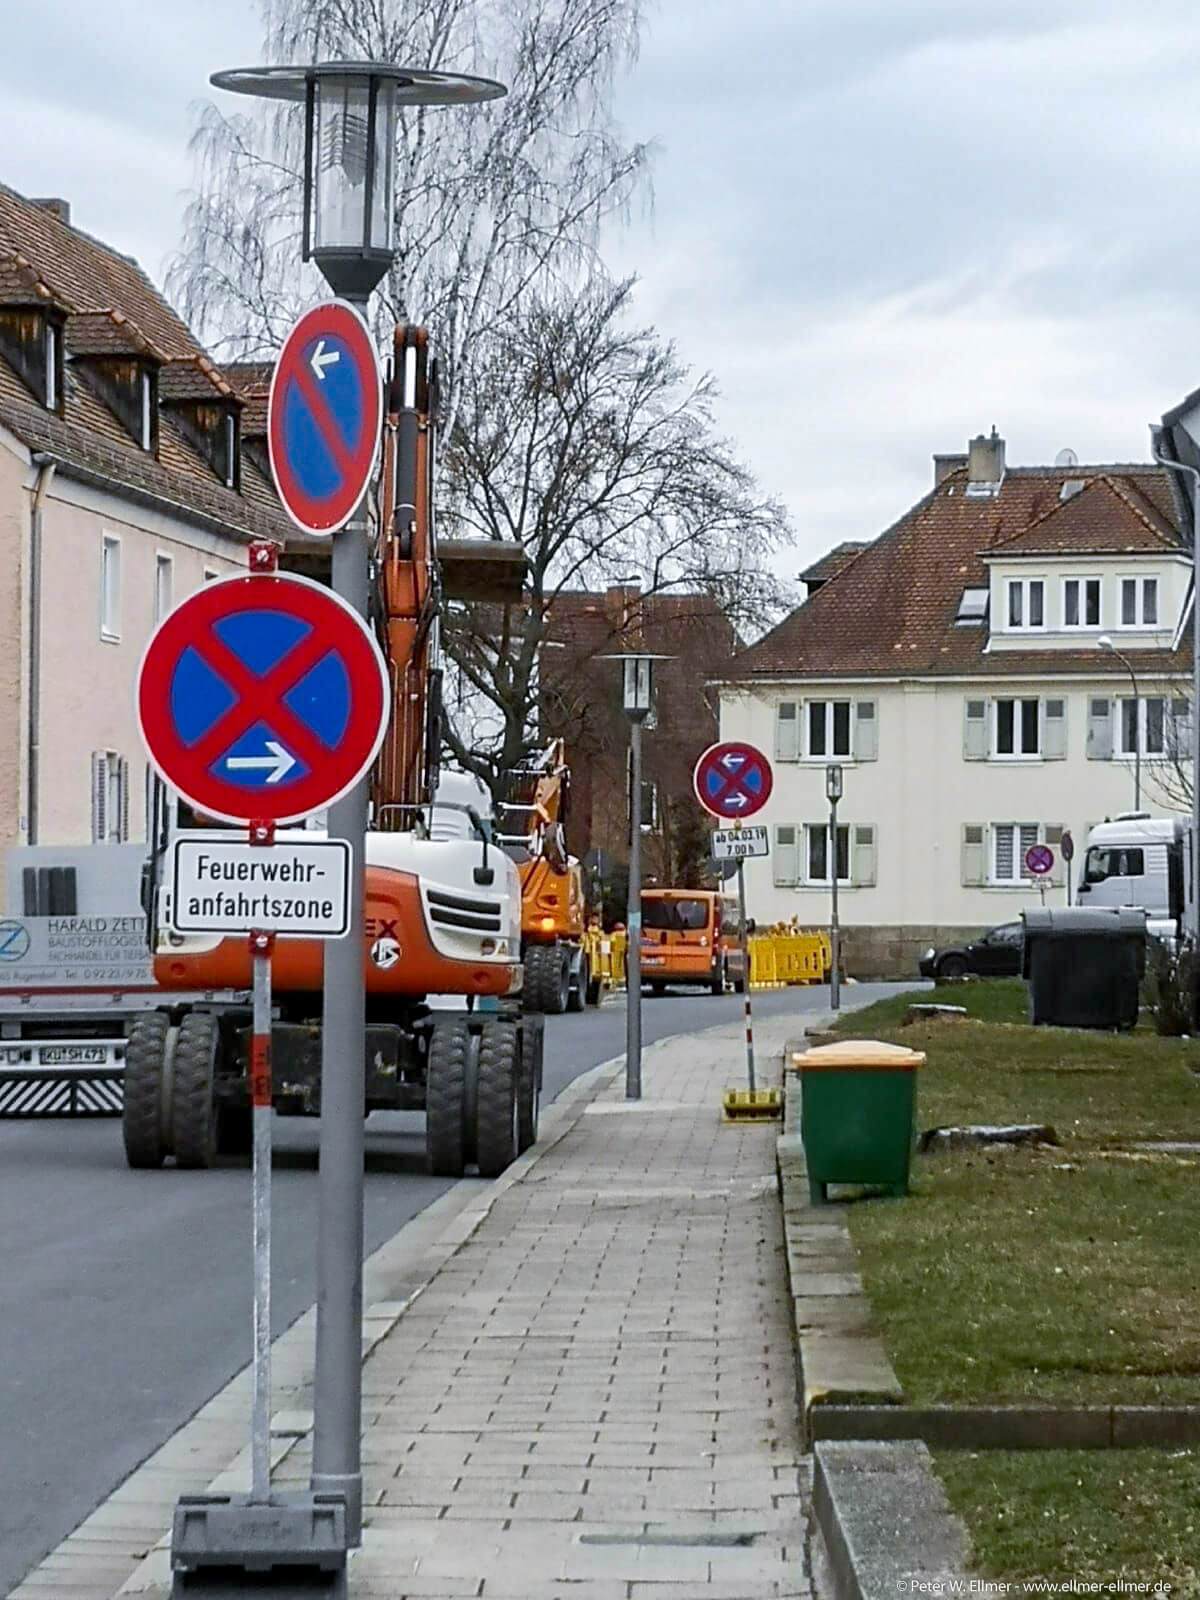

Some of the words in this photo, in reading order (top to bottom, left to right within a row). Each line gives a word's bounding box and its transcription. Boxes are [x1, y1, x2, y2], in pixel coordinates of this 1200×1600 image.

[716, 831, 726, 843] ab
[197, 855, 326, 883] Feuerwehr-
[188, 891, 333, 919] anfahrtszone
[48, 917, 107, 932] HARALD
[112, 916, 146, 931] ZETT
[48, 935, 150, 947] BAUSTOFFLOGIST
